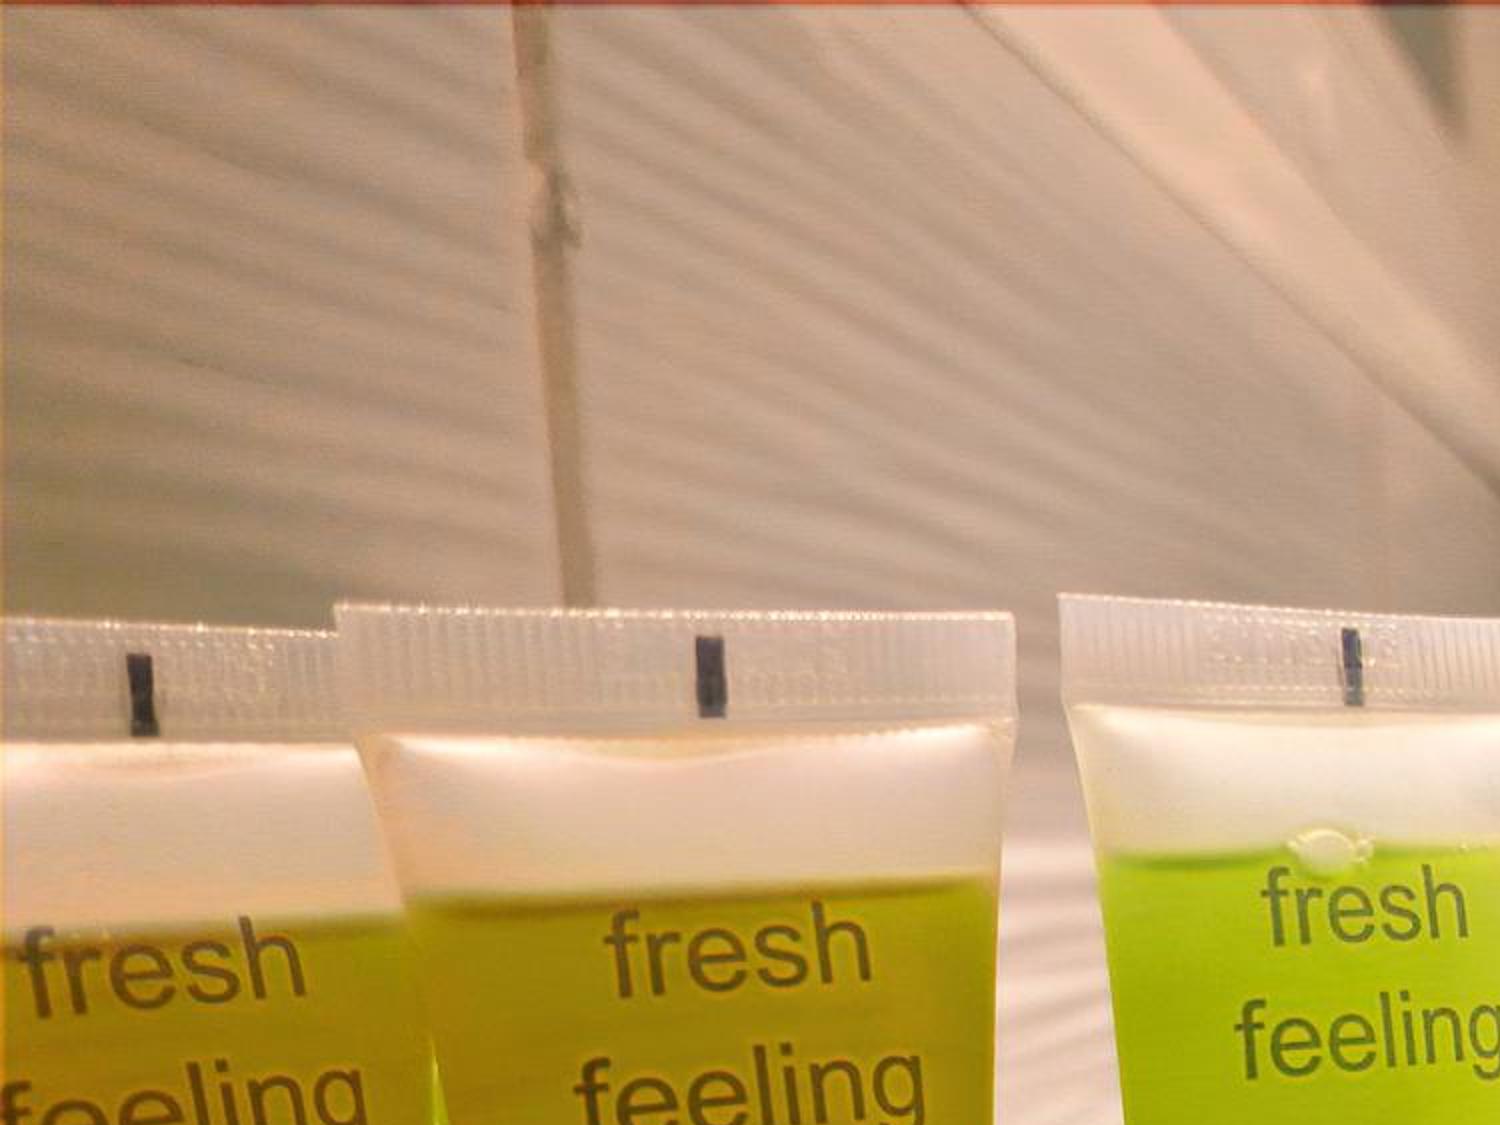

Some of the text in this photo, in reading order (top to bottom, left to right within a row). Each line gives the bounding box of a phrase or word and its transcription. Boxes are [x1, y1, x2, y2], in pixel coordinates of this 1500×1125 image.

[603, 900, 872, 999] fresh
[1260, 863, 1470, 947] fresh
[16, 915, 307, 1019] fresh
